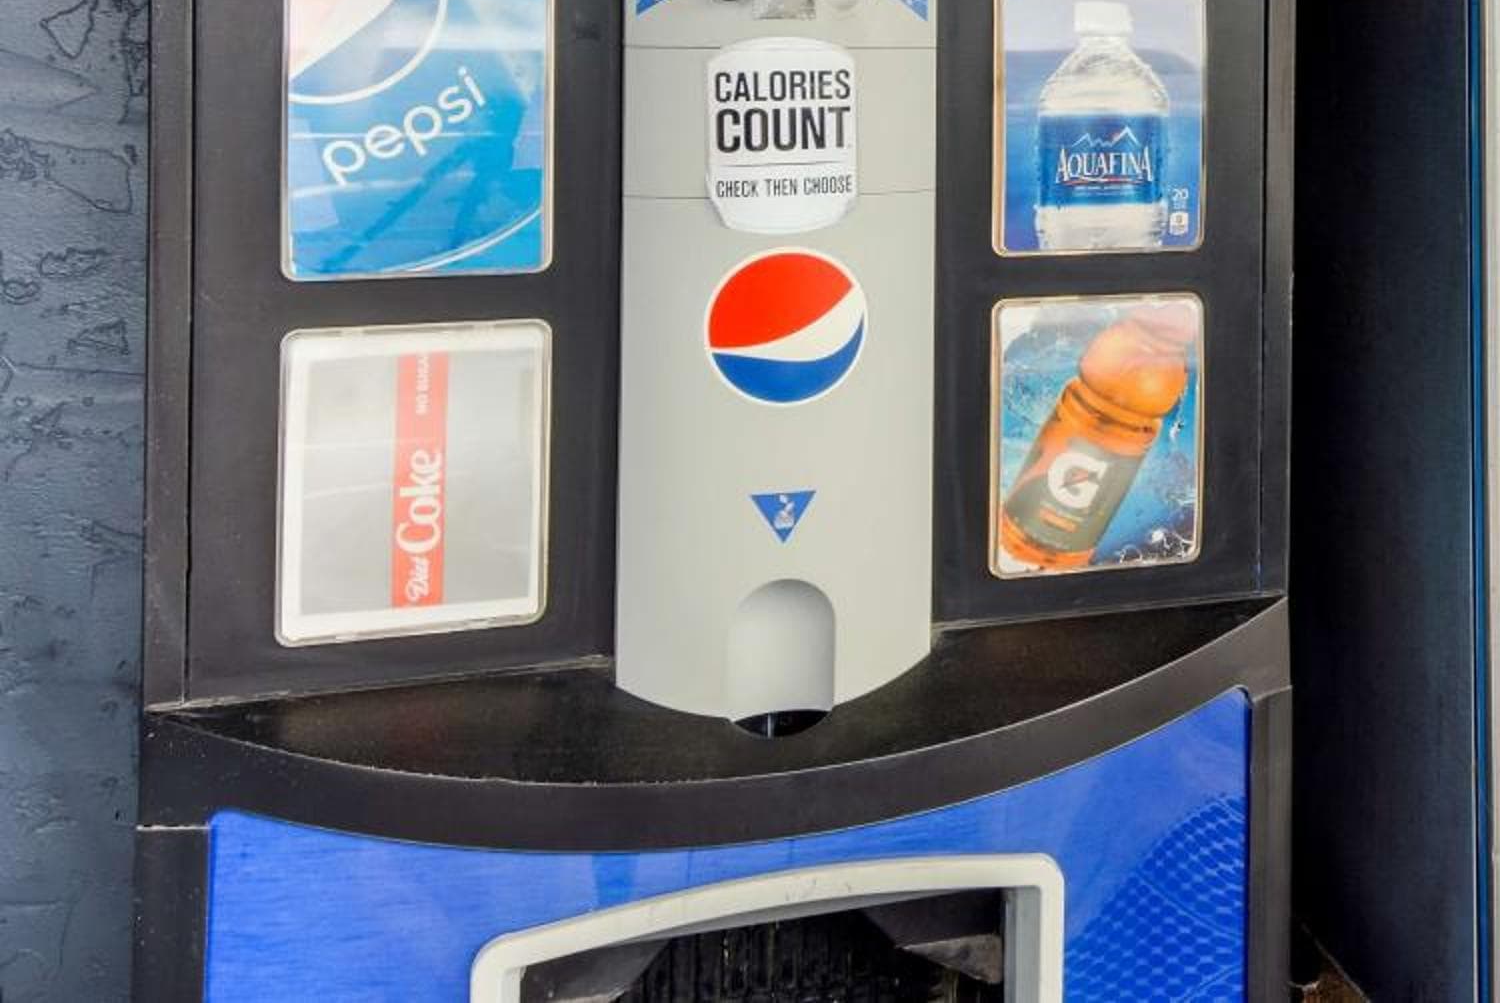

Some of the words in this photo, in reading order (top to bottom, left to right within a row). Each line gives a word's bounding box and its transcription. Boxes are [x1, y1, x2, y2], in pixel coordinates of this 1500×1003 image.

[714, 69, 851, 103] CALORIES
[321, 65, 486, 187] pepsi
[715, 106, 851, 154] COUNT
[715, 178, 759, 199] CHECK
[764, 177, 798, 197] THEN
[803, 174, 853, 196] CHOOSE
[1055, 147, 1153, 184] AQUAFINA
[395, 449, 445, 556] Coke
